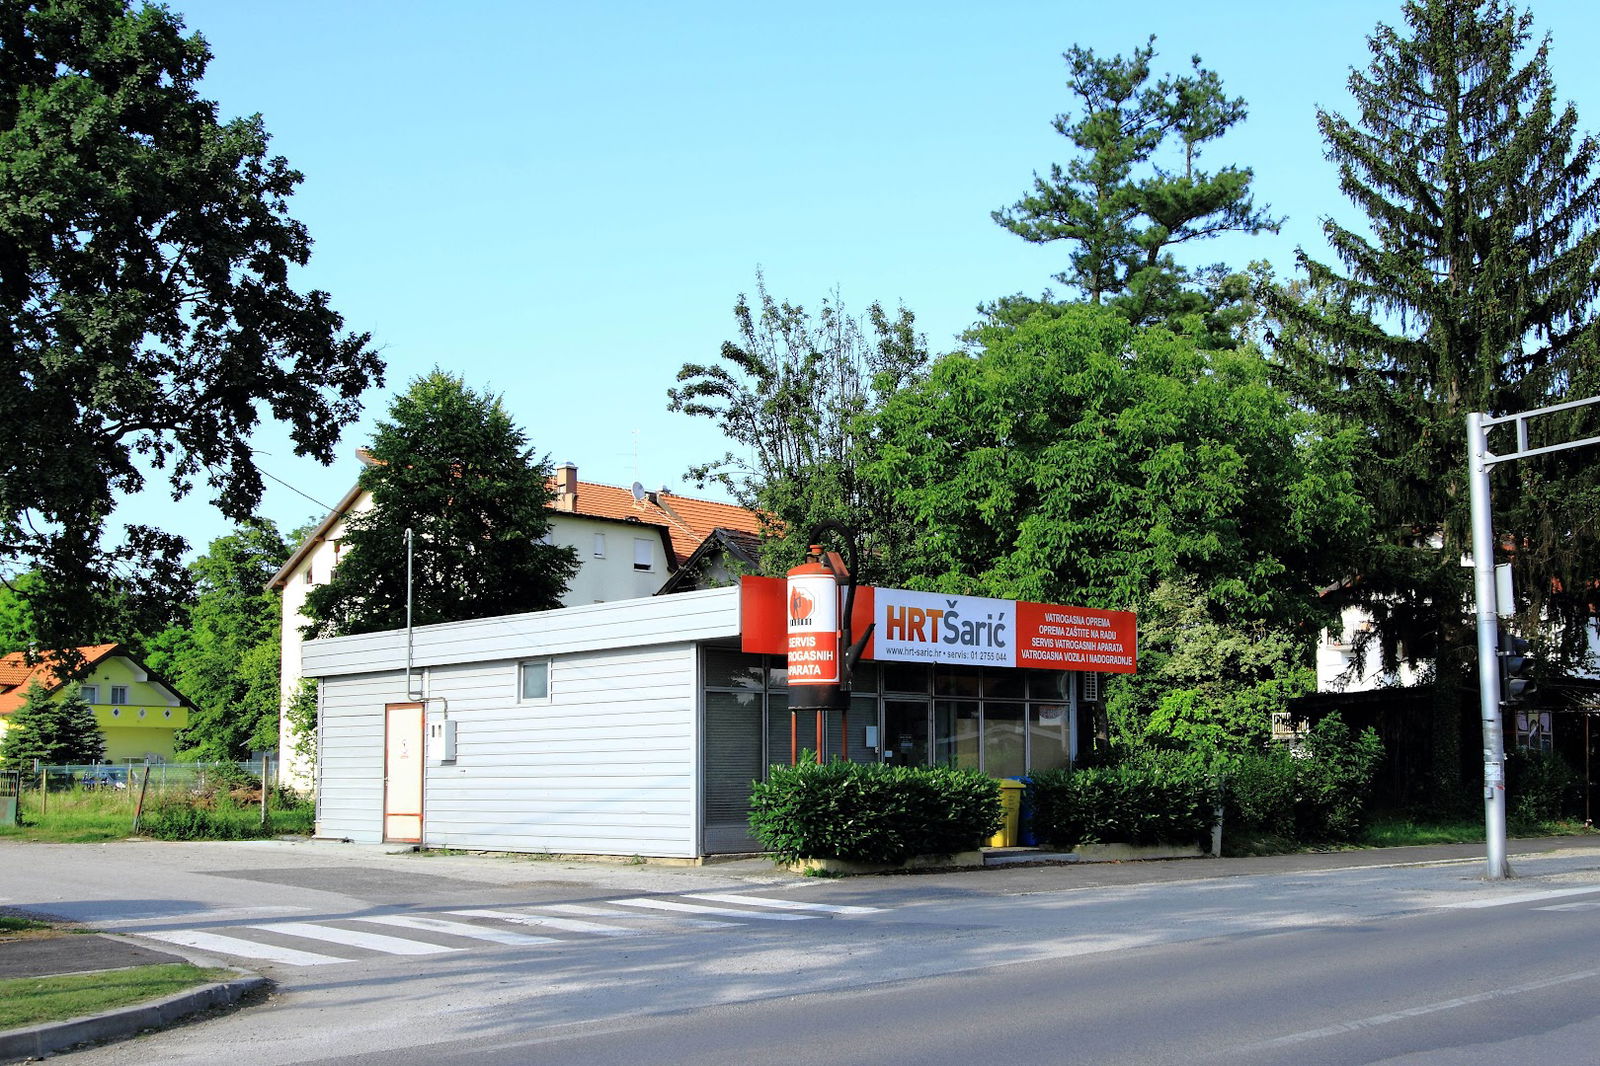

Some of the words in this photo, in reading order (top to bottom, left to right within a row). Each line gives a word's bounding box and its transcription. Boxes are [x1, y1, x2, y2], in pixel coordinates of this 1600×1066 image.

[1045, 613, 1085, 625] VATROGASNA
[1086, 616, 1110, 627] OPREMA
[1039, 625, 1065, 636] OPREMA
[1066, 626, 1090, 638] ZAŠTITE
[1091, 629, 1099, 638] NA
[1100, 630, 1116, 640] RADU
[788, 636, 816, 648] SERVIS
[1031, 637, 1054, 648] SERVIS
[1055, 639, 1096, 650] VATROGASNIH
[1097, 642, 1123, 652] APARATA
[886, 646, 941, 658] www.hrt-saric.hr
[947, 650, 969, 659] servis:
[971, 650, 977, 659] 01
[980, 651, 994, 660] 2755
[1021, 649, 1063, 660] VATROGASNA
[1064, 652, 1085, 662] VOZILA
[1089, 654, 1132, 665] NADOGRADNJE
